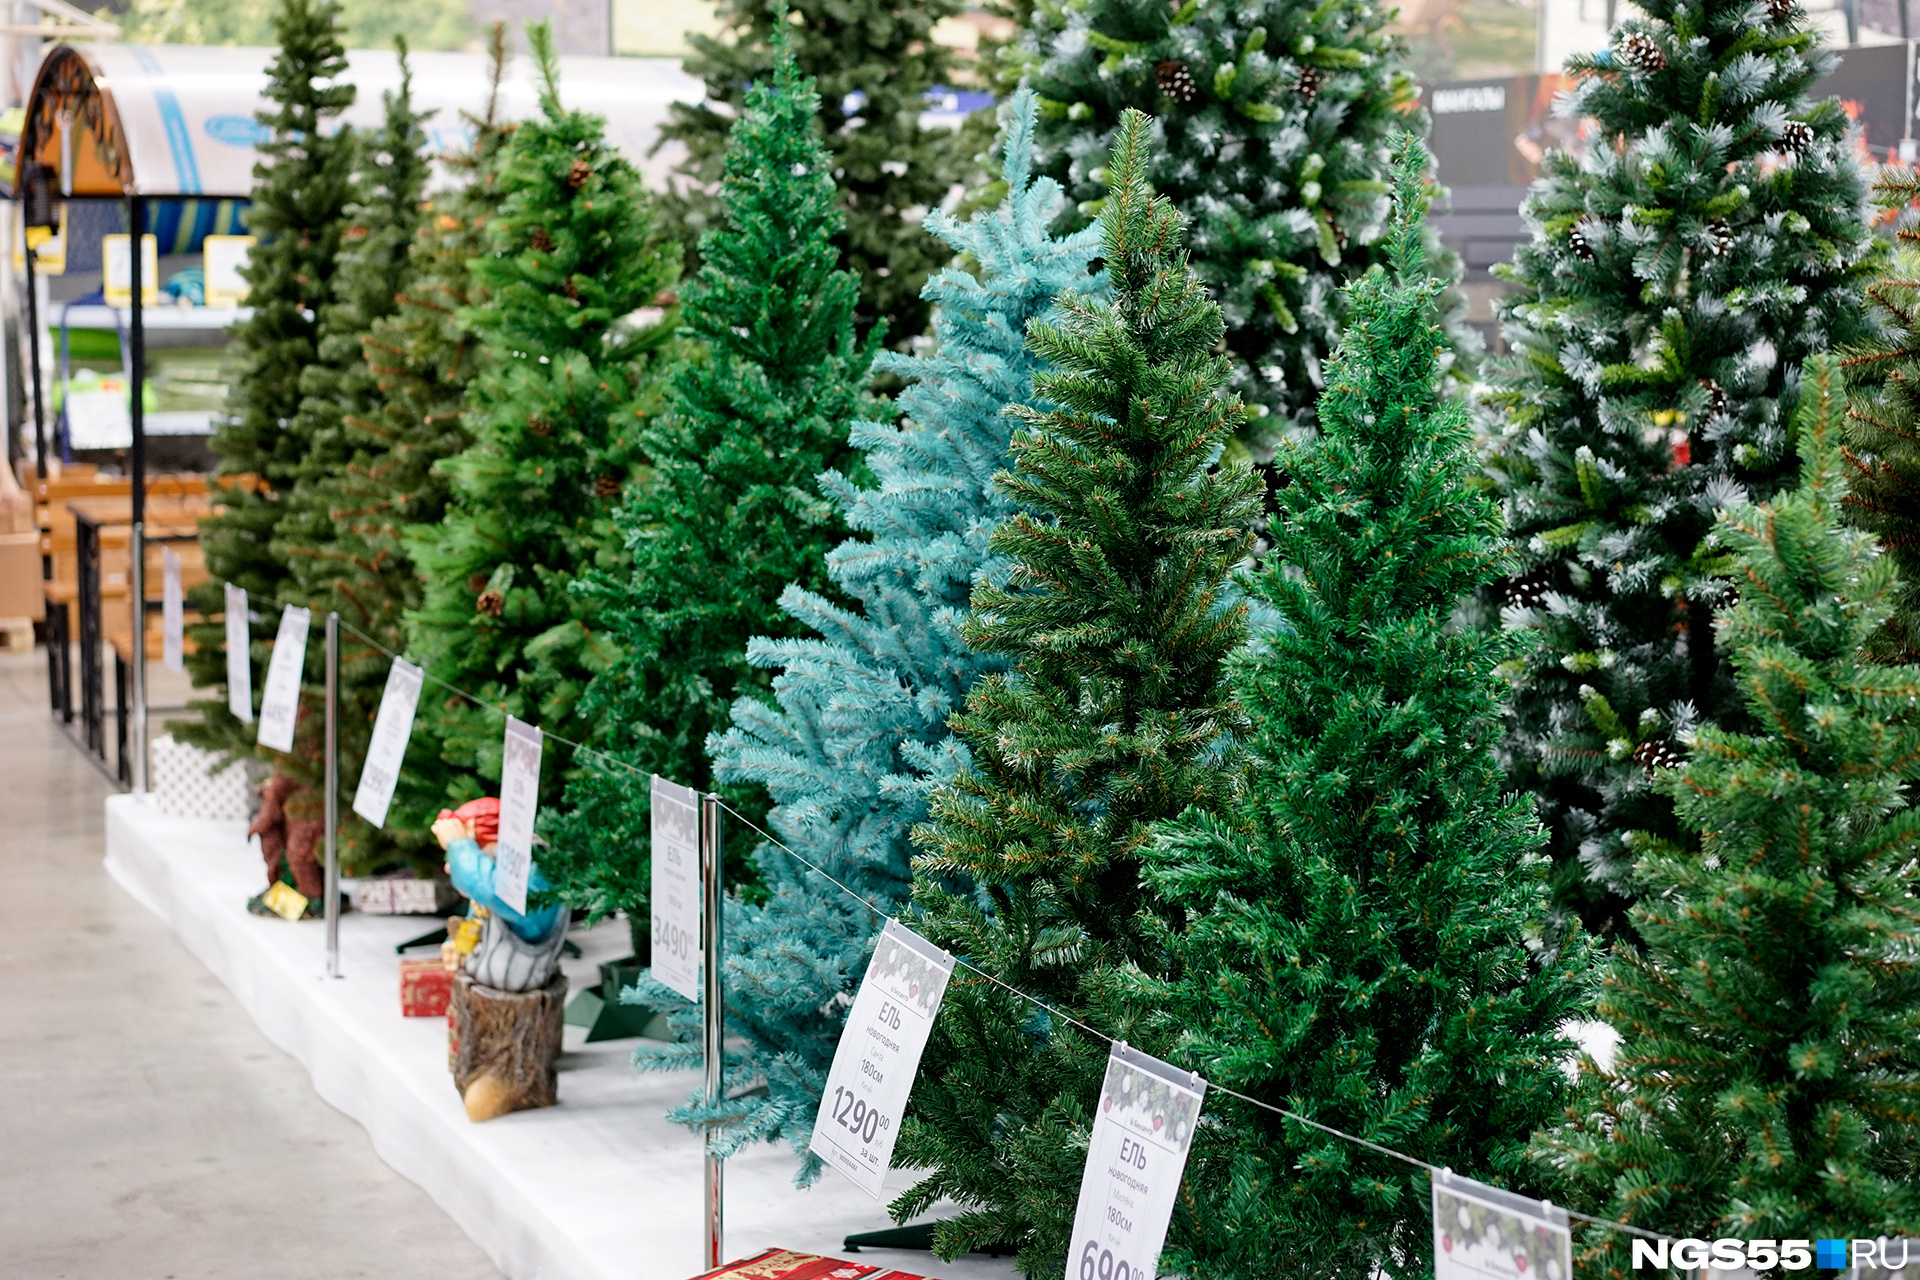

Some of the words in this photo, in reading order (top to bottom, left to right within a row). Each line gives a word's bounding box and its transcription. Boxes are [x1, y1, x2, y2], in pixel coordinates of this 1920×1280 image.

[654, 914, 688, 961] 3490
[878, 1001, 901, 1031] ЕЛЬ
[866, 1026, 900, 1054] новогодняя
[861, 1059, 884, 1084] 180см
[832, 1085, 879, 1144] 1290
[860, 1147, 868, 1158] за
[868, 1152, 880, 1167] шт.
[1119, 1137, 1147, 1170] ЕЛЬ
[1107, 1165, 1149, 1195] новогодняя
[1107, 1205, 1133, 1233] 180см
